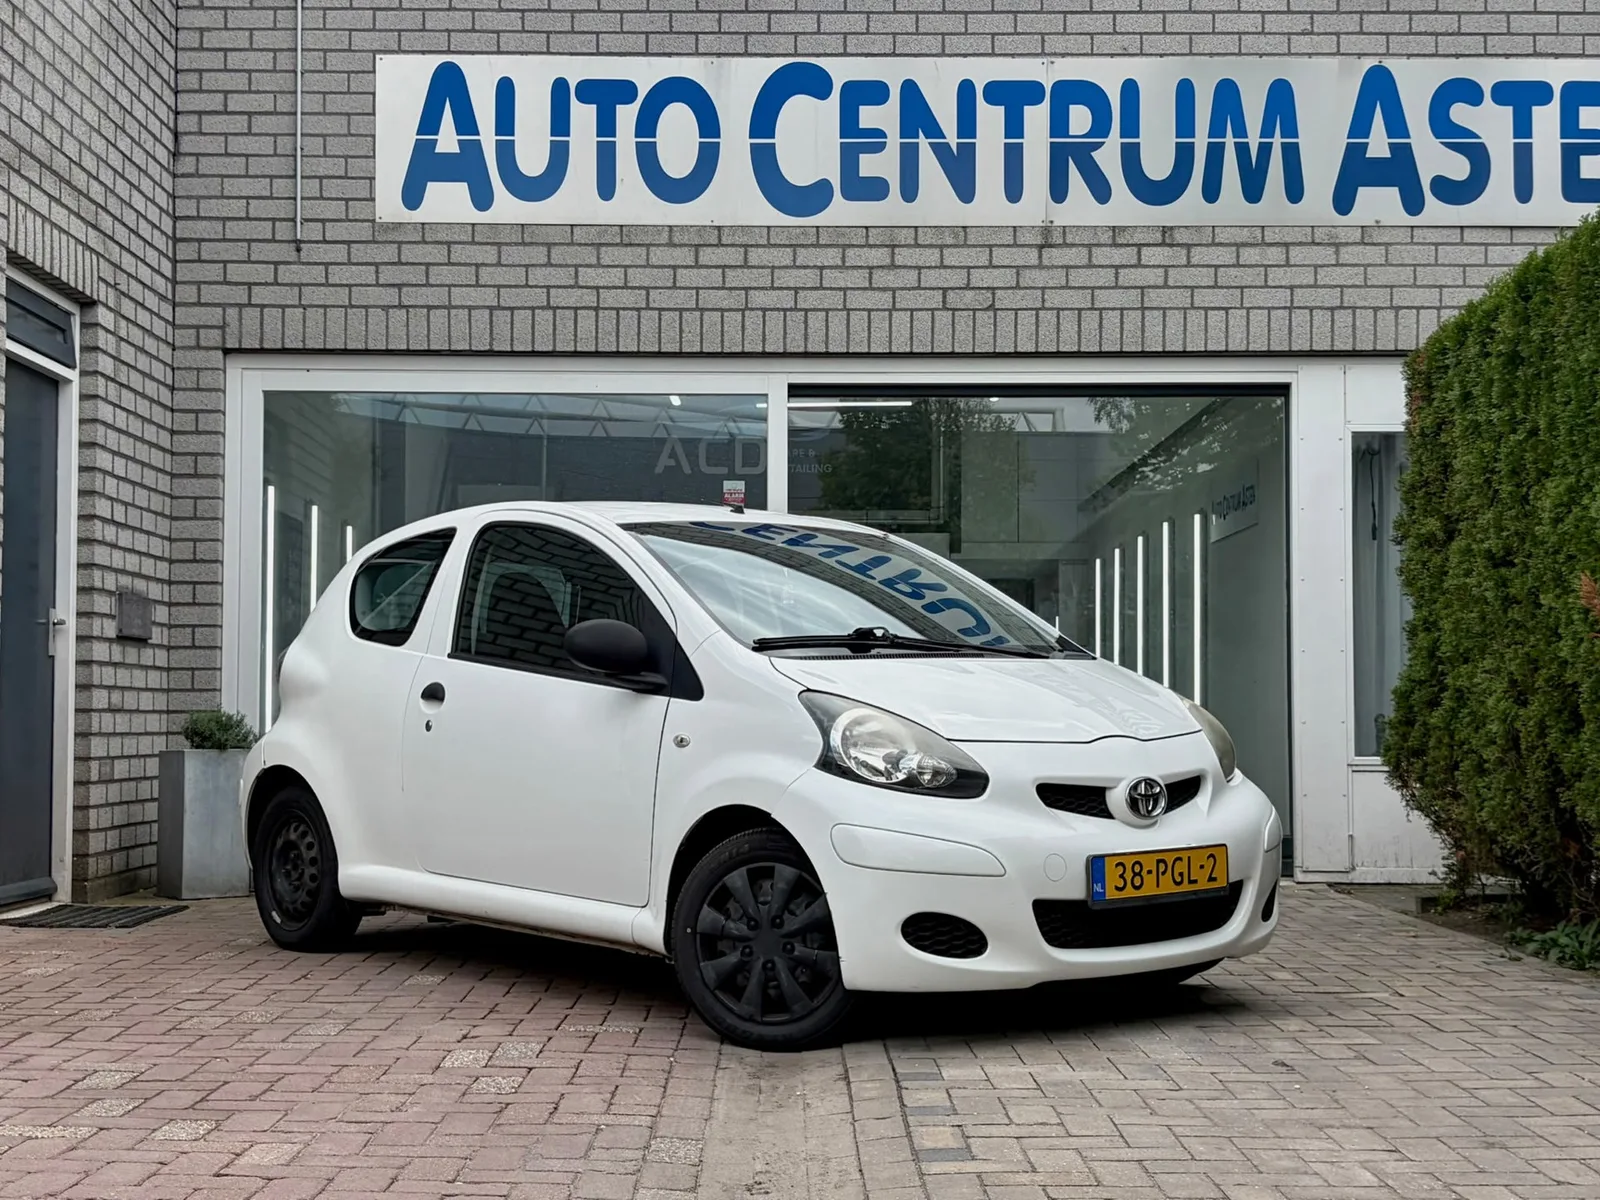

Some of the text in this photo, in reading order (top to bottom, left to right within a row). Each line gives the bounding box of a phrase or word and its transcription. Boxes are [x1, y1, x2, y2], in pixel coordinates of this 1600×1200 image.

[401, 61, 721, 212] AUTO
[748, 62, 1304, 217] CENTRUM
[654, 435, 766, 474] ACD
[788, 449, 805, 457] RE
[1093, 882, 1104, 893] NL
[1114, 853, 1218, 892] 38-PGL-2
